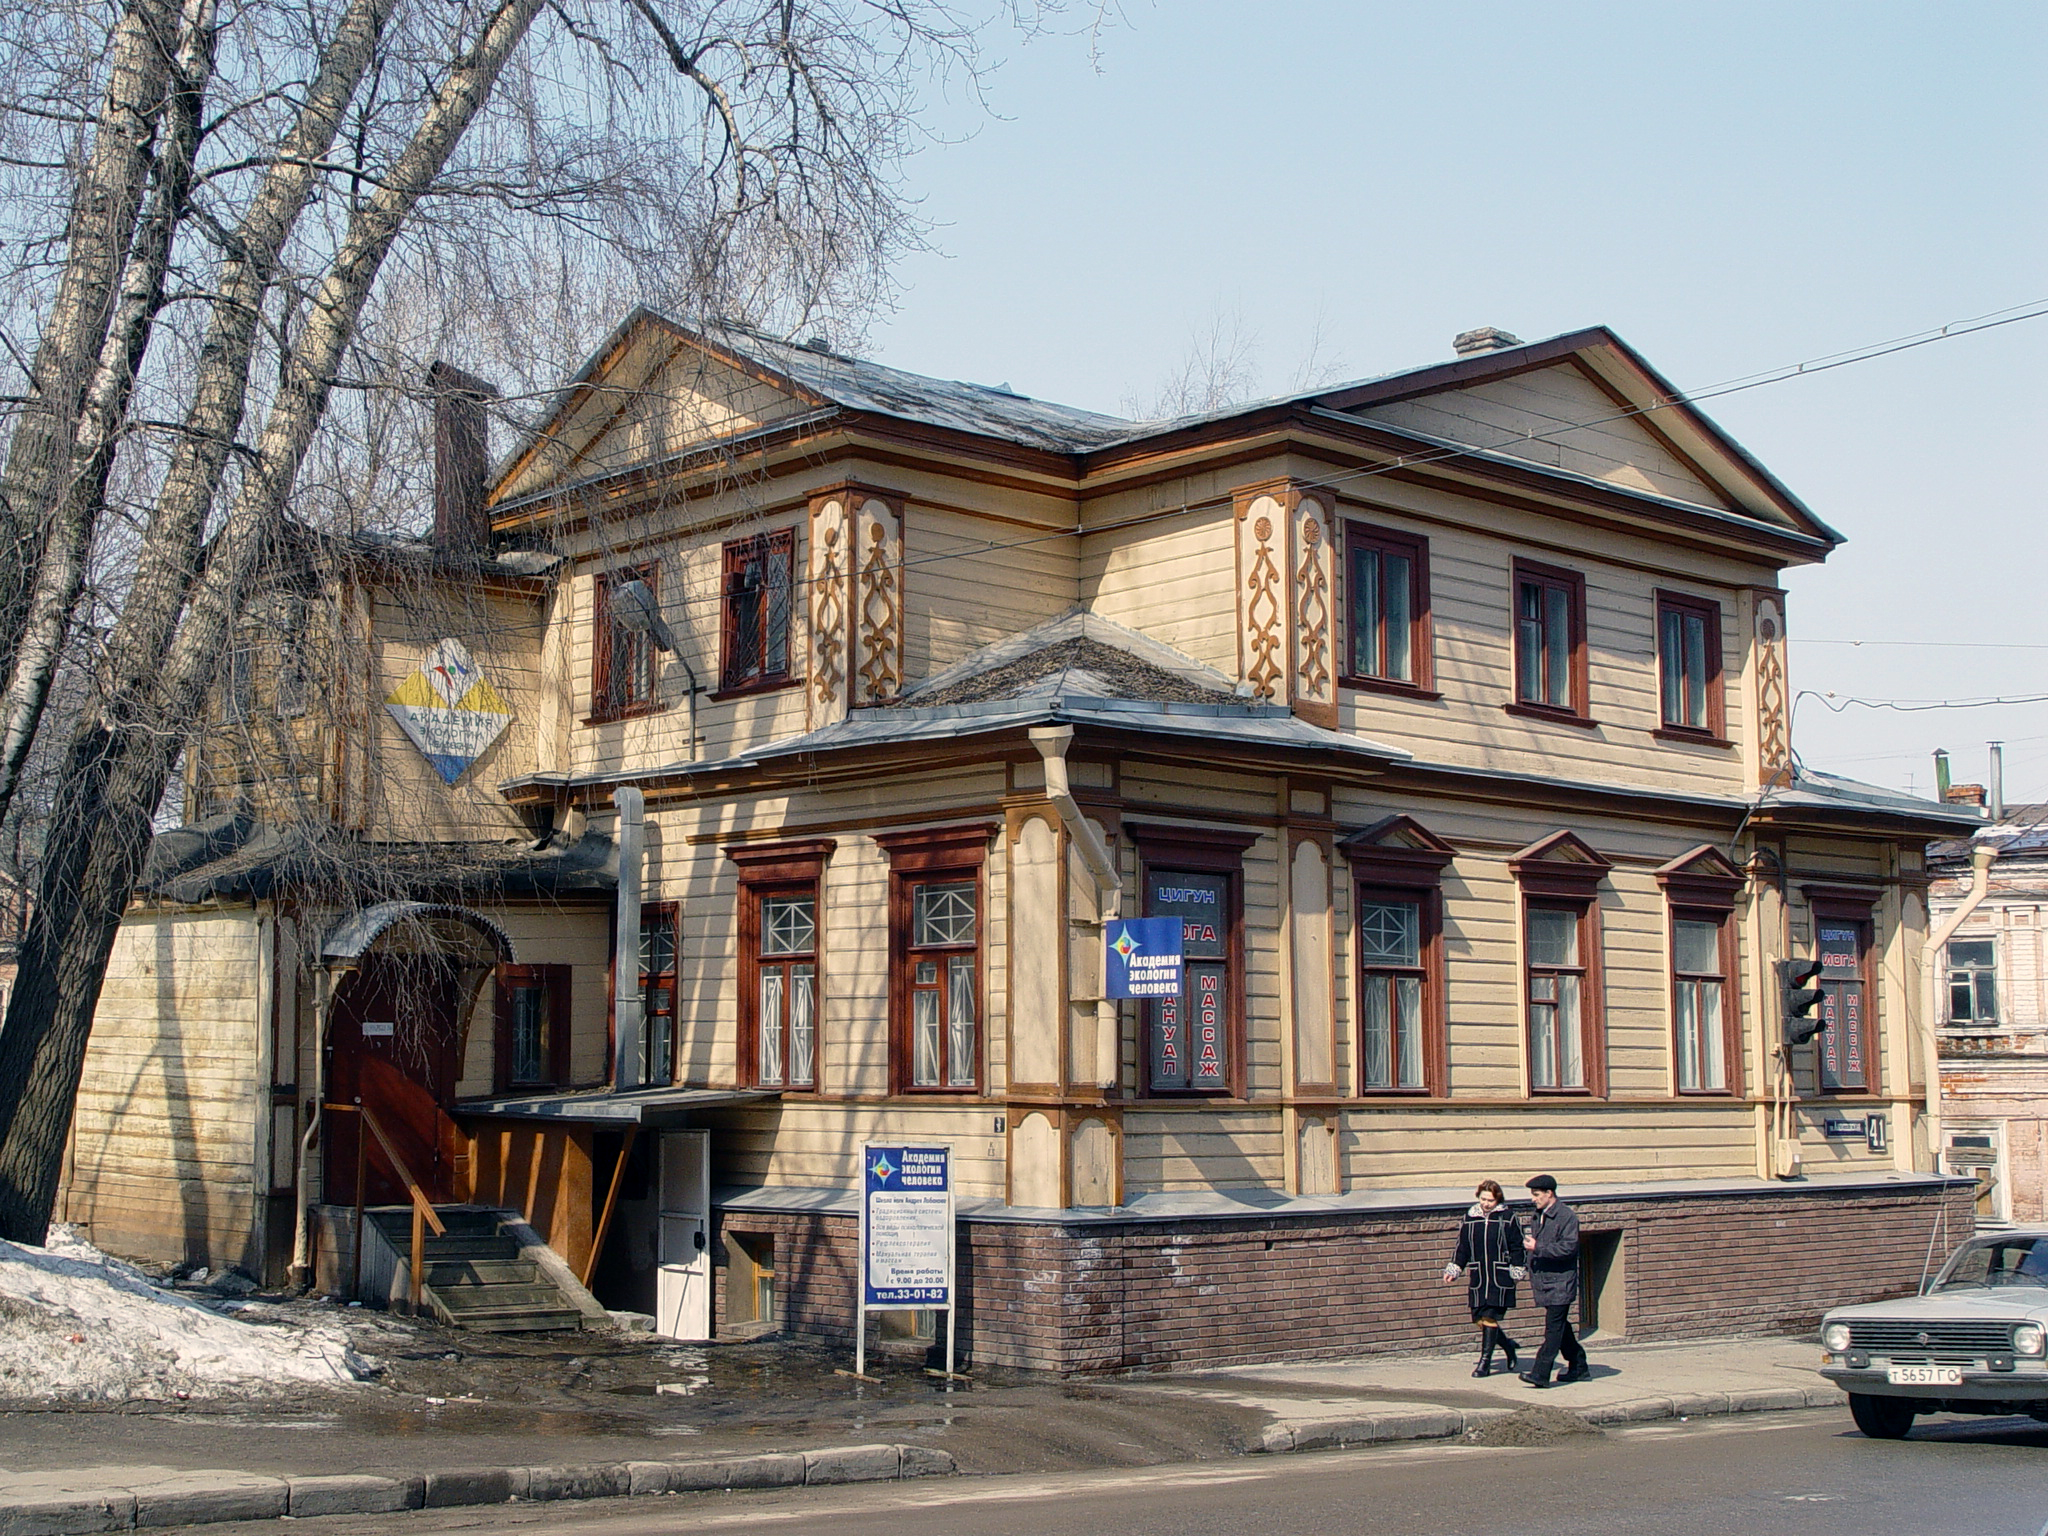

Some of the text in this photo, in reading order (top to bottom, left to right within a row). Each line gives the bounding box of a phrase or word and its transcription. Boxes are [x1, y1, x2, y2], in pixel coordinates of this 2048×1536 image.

[410, 712, 492, 727] АКАДЕМИЯ
[1158, 886, 1215, 904] ЦИГУН
[1821, 928, 1856, 942] ЦИГУН
[1129, 953, 1181, 970] Академия
[1822, 952, 1857, 968] ЙОГА
[1129, 969, 1177, 981] экологии
[1129, 982, 1178, 995] человека
[1198, 975, 1220, 1077] МАССАЖ
[1824, 994, 1837, 1072] МАНУАЛ
[1847, 994, 1861, 1072] МАССАЖ
[1161, 996, 1178, 1075] АНУАЛ
[1869, 1118, 1885, 1147] 41
[901, 1150, 945, 1164] Академия
[901, 1164, 942, 1175] экологии
[901, 1175, 943, 1186] человека
[916, 1267, 943, 1275] работы
